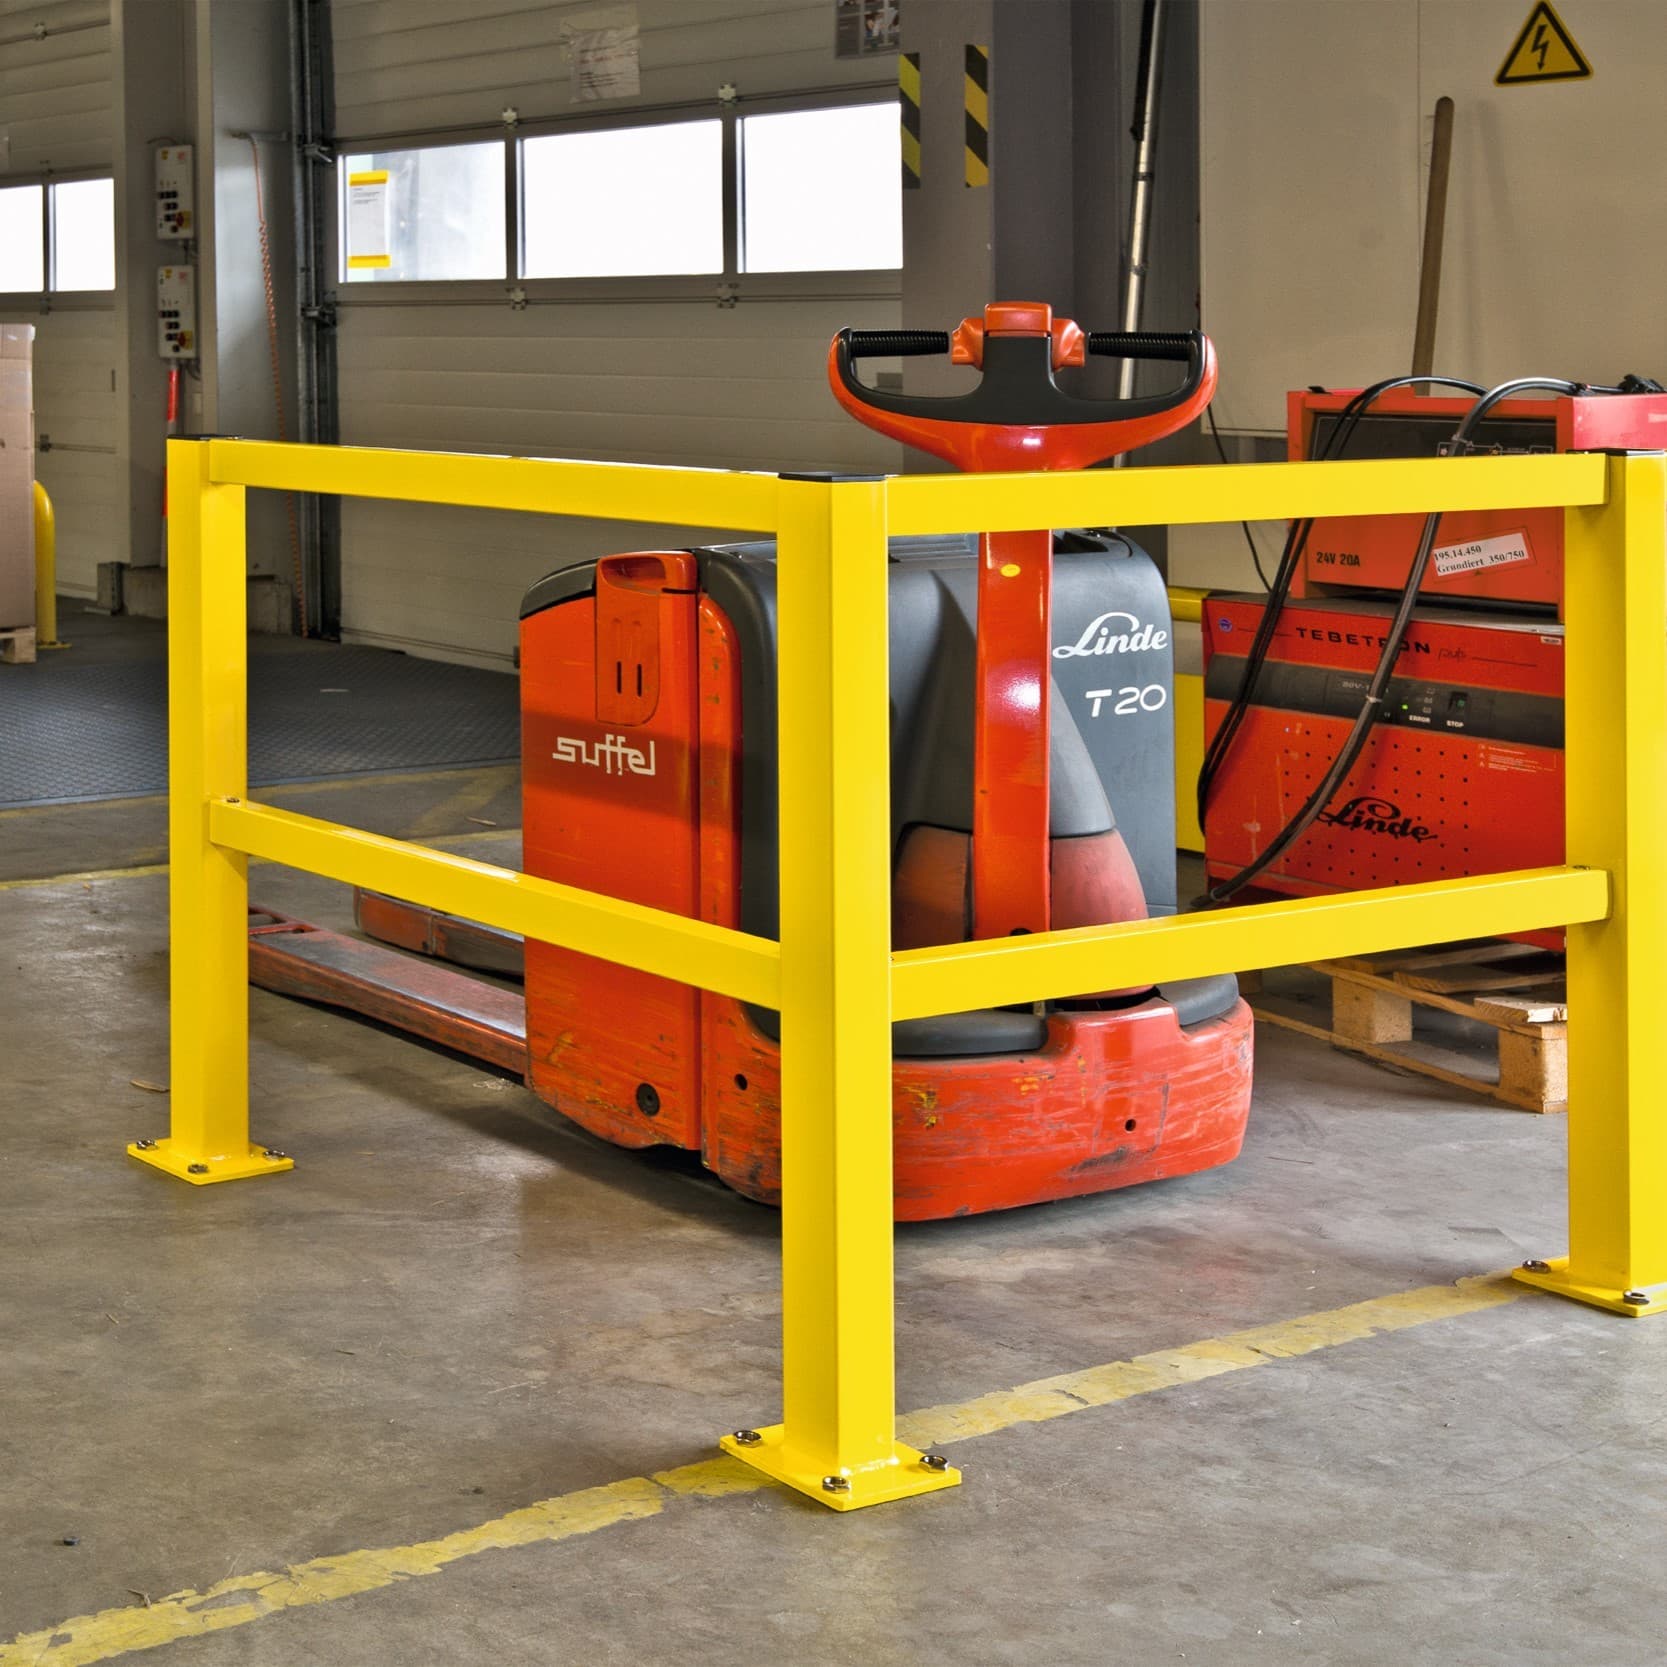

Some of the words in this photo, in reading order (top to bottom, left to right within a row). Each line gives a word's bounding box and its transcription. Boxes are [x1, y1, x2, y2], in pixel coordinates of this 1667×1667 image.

[1316, 551, 1336, 565] 24V
[1340, 553, 1361, 567] 20A
[1434, 544, 1482, 561] 195.14.450
[1437, 557, 1485, 574] Grundiert
[1489, 549, 1525, 565] 350/750
[1052, 611, 1168, 659] Linde
[1085, 688, 1113, 718] T
[1114, 684, 1167, 715] 20
[1408, 714, 1431, 724] ERROR
[552, 733, 656, 776] suffel
[1317, 796, 1439, 842] Linde
